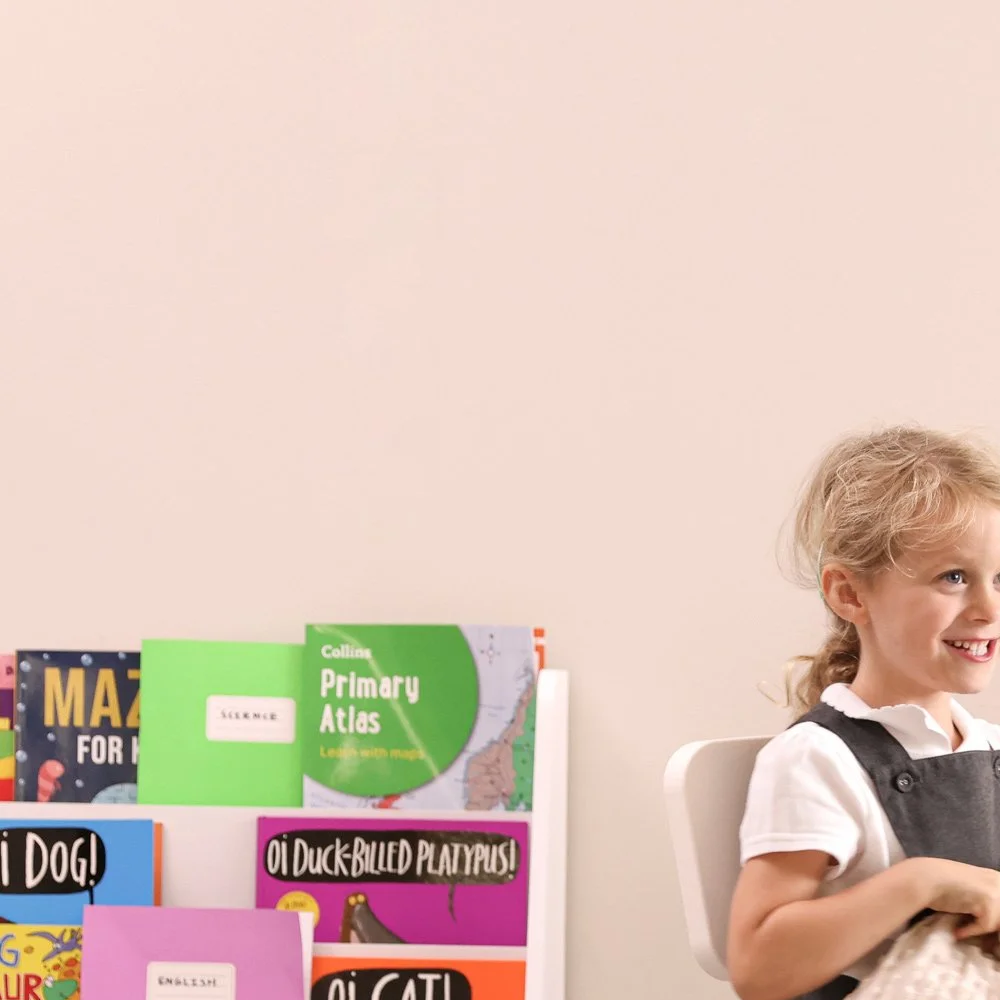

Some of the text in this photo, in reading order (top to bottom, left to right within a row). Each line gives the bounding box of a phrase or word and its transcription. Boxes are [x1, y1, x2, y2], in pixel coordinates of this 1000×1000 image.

[320, 644, 372, 659] Collins
[320, 668, 419, 704] Primary
[319, 703, 381, 734] Atlas
[77, 734, 123, 765] FOR
[320, 745, 425, 761] Learn with maps
[25, 831, 97, 889] DOG!
[416, 838, 516, 880] PLATYPUS!
[158, 975, 217, 988] ENGLISH
